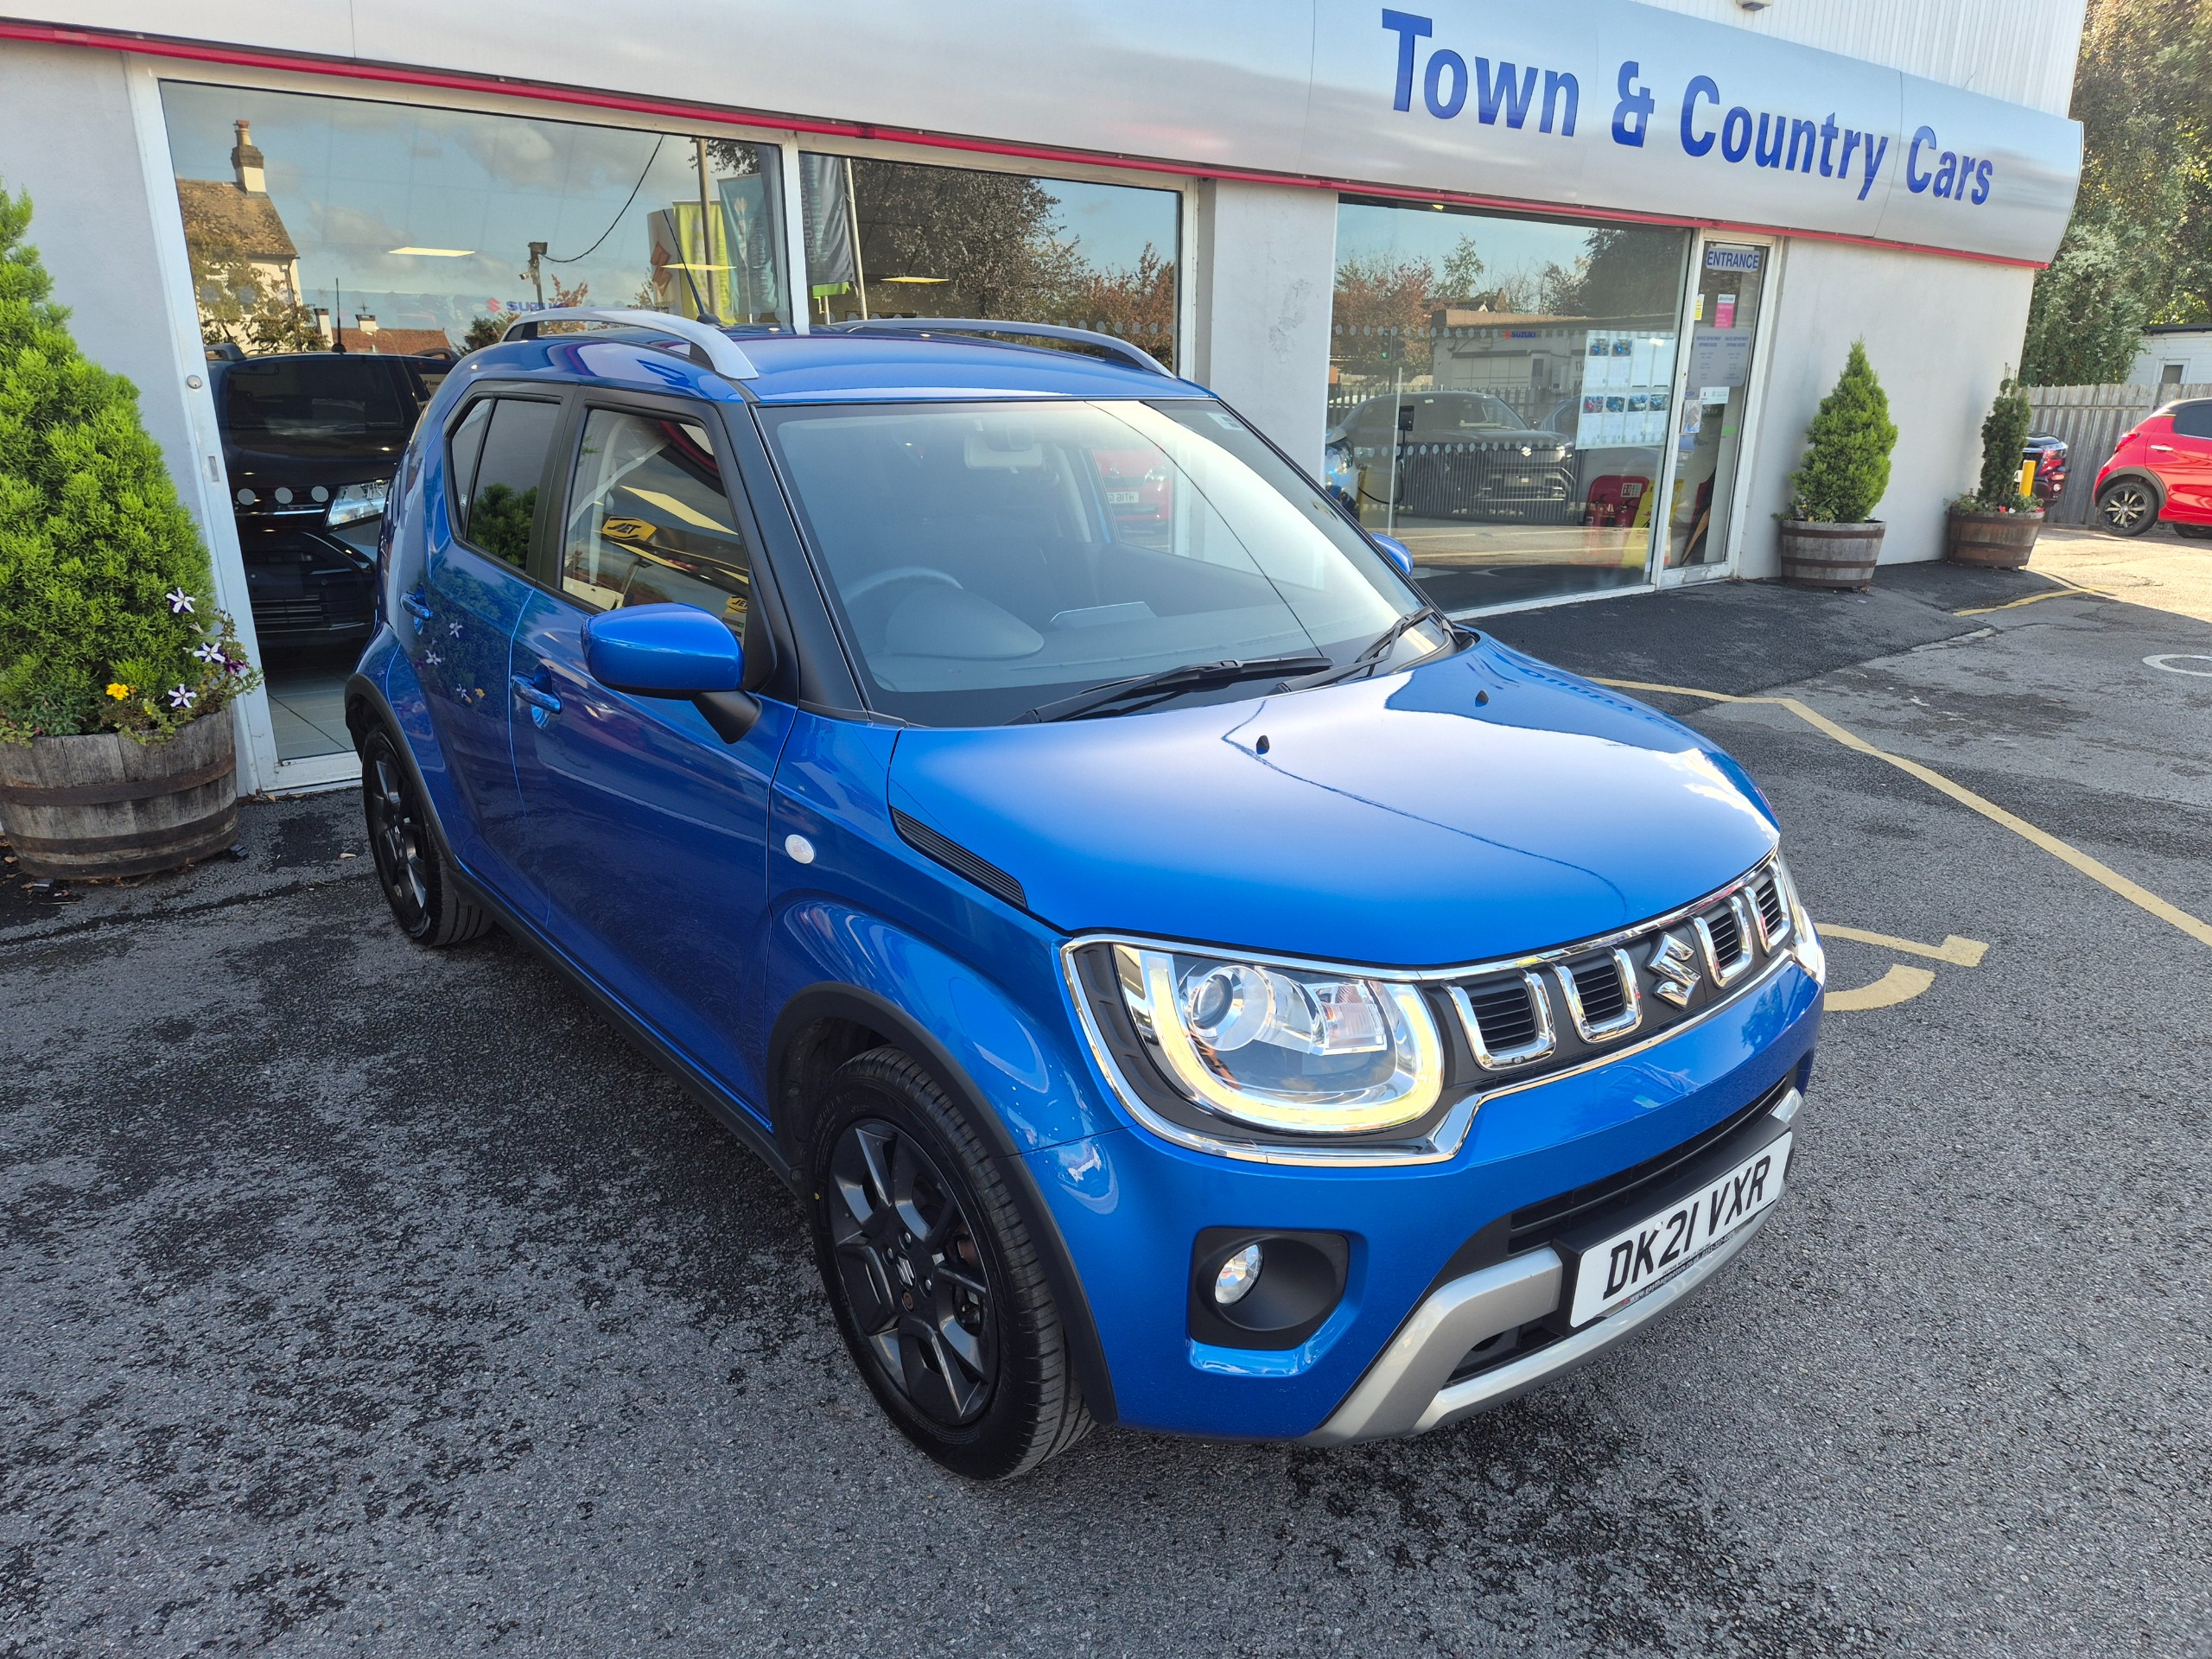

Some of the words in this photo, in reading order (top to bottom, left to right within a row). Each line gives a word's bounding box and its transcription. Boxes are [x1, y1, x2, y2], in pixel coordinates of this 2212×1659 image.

[1382, 8, 1580, 137] Town
[1611, 60, 1655, 147] &
[1681, 74, 1890, 200] Country
[1906, 125, 1993, 205] Cars
[1707, 251, 1759, 269] ENTRANCE
[505, 301, 568, 312] SUZU
[607, 523, 642, 534] JET
[1602, 1200, 1700, 1300] DK21
[1708, 1154, 1771, 1236] VXR
